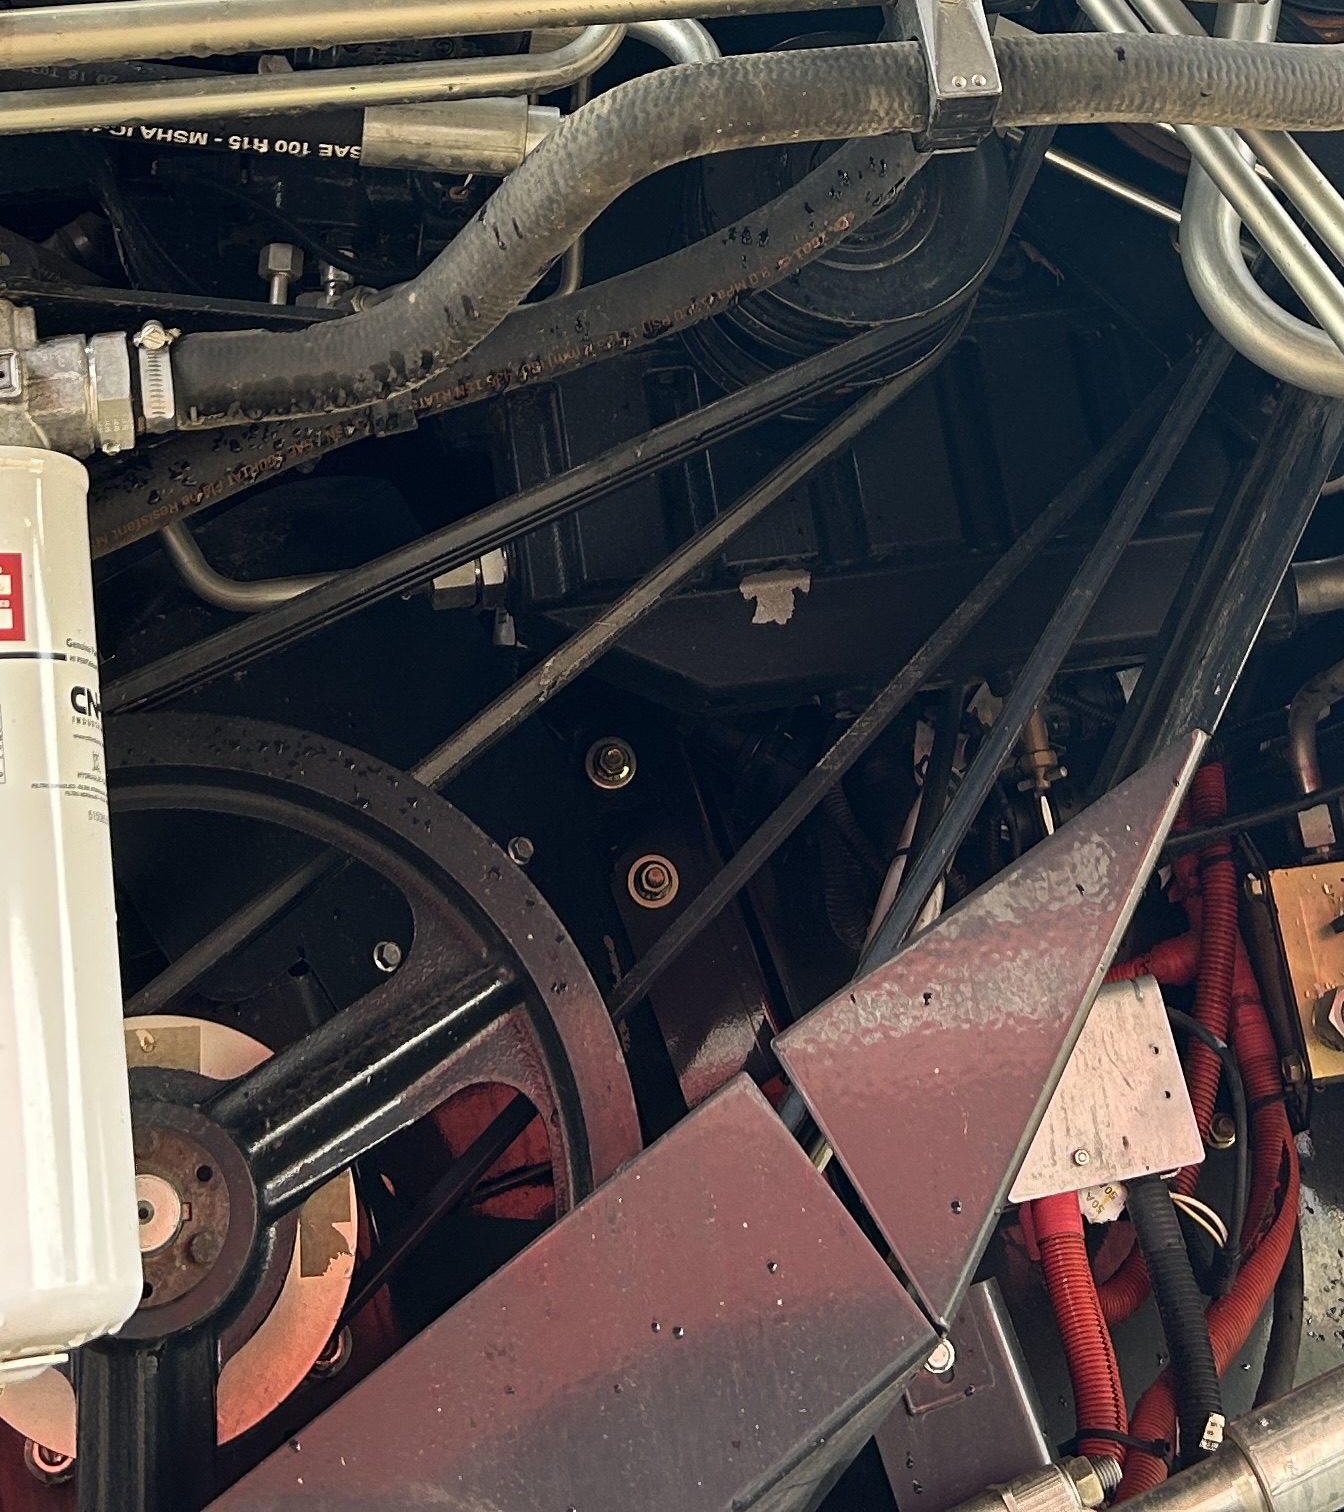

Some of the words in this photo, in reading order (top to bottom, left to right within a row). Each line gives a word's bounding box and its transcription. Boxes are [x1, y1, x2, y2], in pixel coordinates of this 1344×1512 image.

[140, 125, 209, 146] MSHA
[228, 135, 269, 154] R15
[273, 139, 312, 157] 100
[318, 142, 362, 160] SAE
[1086, 1191, 1106, 1215] 50A
